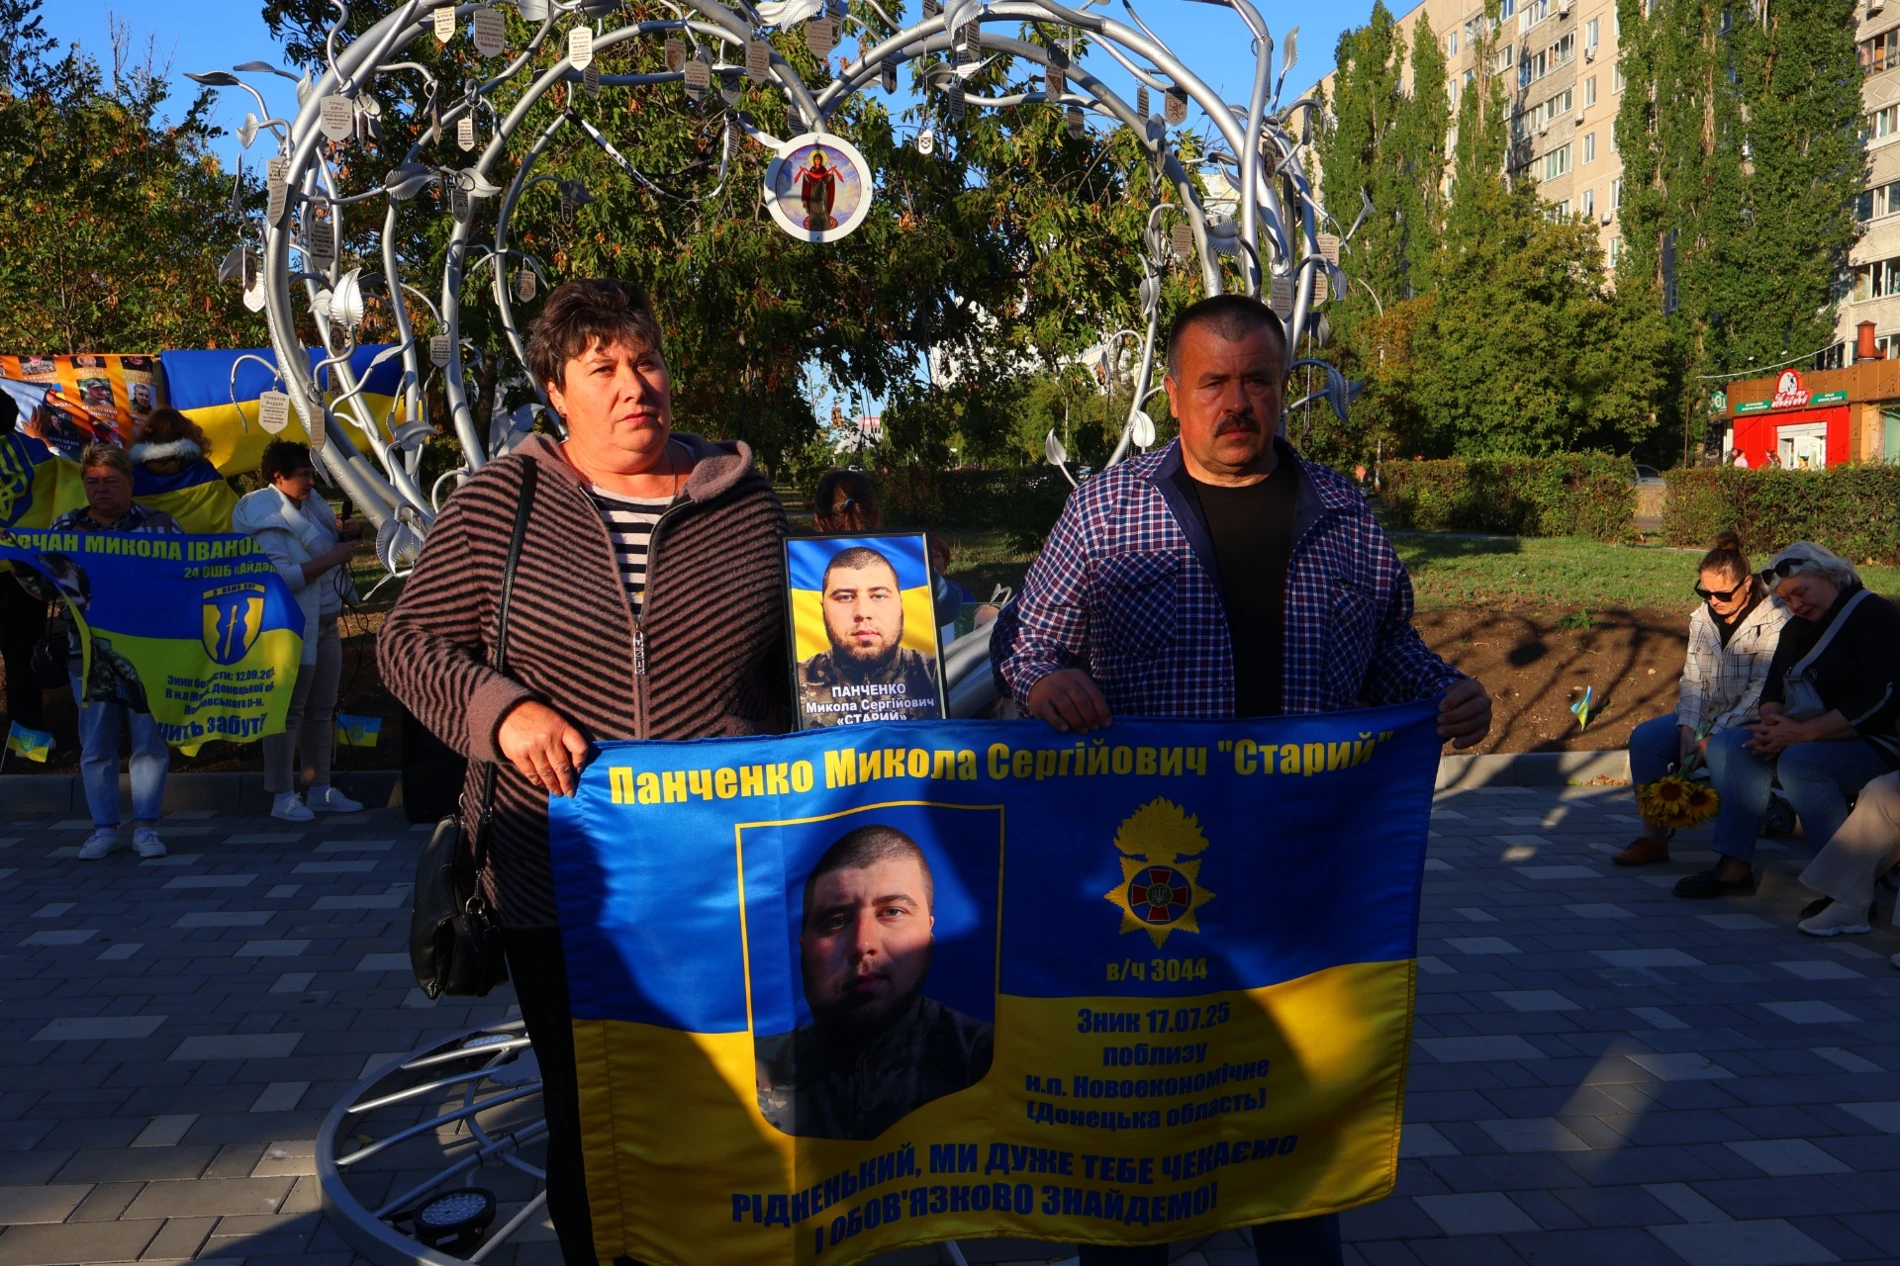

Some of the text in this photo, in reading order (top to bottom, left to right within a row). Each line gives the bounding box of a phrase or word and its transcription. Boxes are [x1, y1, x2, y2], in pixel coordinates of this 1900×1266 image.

[10, 532, 79, 551] ВЧАН
[85, 535, 182, 561] МИКОЛА
[184, 567, 199, 578] 24
[203, 565, 231, 578] ОШБ
[806, 697, 935, 713] Микола Сергійович
[832, 683, 906, 698] ПАНЧЕНКО
[837, 709, 907, 726] «СТАРИЙ»
[608, 730, 1394, 804] Панченко Микола Сергійович "Старий"
[1106, 958, 1208, 982] в/ч 3044
[1077, 1001, 1231, 1033] Зник 17.07.25
[1103, 1042, 1208, 1067] поблизу
[1025, 1058, 1270, 1098] н.п. Новоекономічне
[1026, 1087, 1267, 1132] (Донецька область)
[731, 1133, 1298, 1228] РІДНЕНЬКИЙ, МИ ДУЖЕ ТЕБЕ ЧЕКАЄМО
[814, 1181, 1219, 1255] І ОБОВ'ЯЗКОВО ЗНАЙДЕМО!
